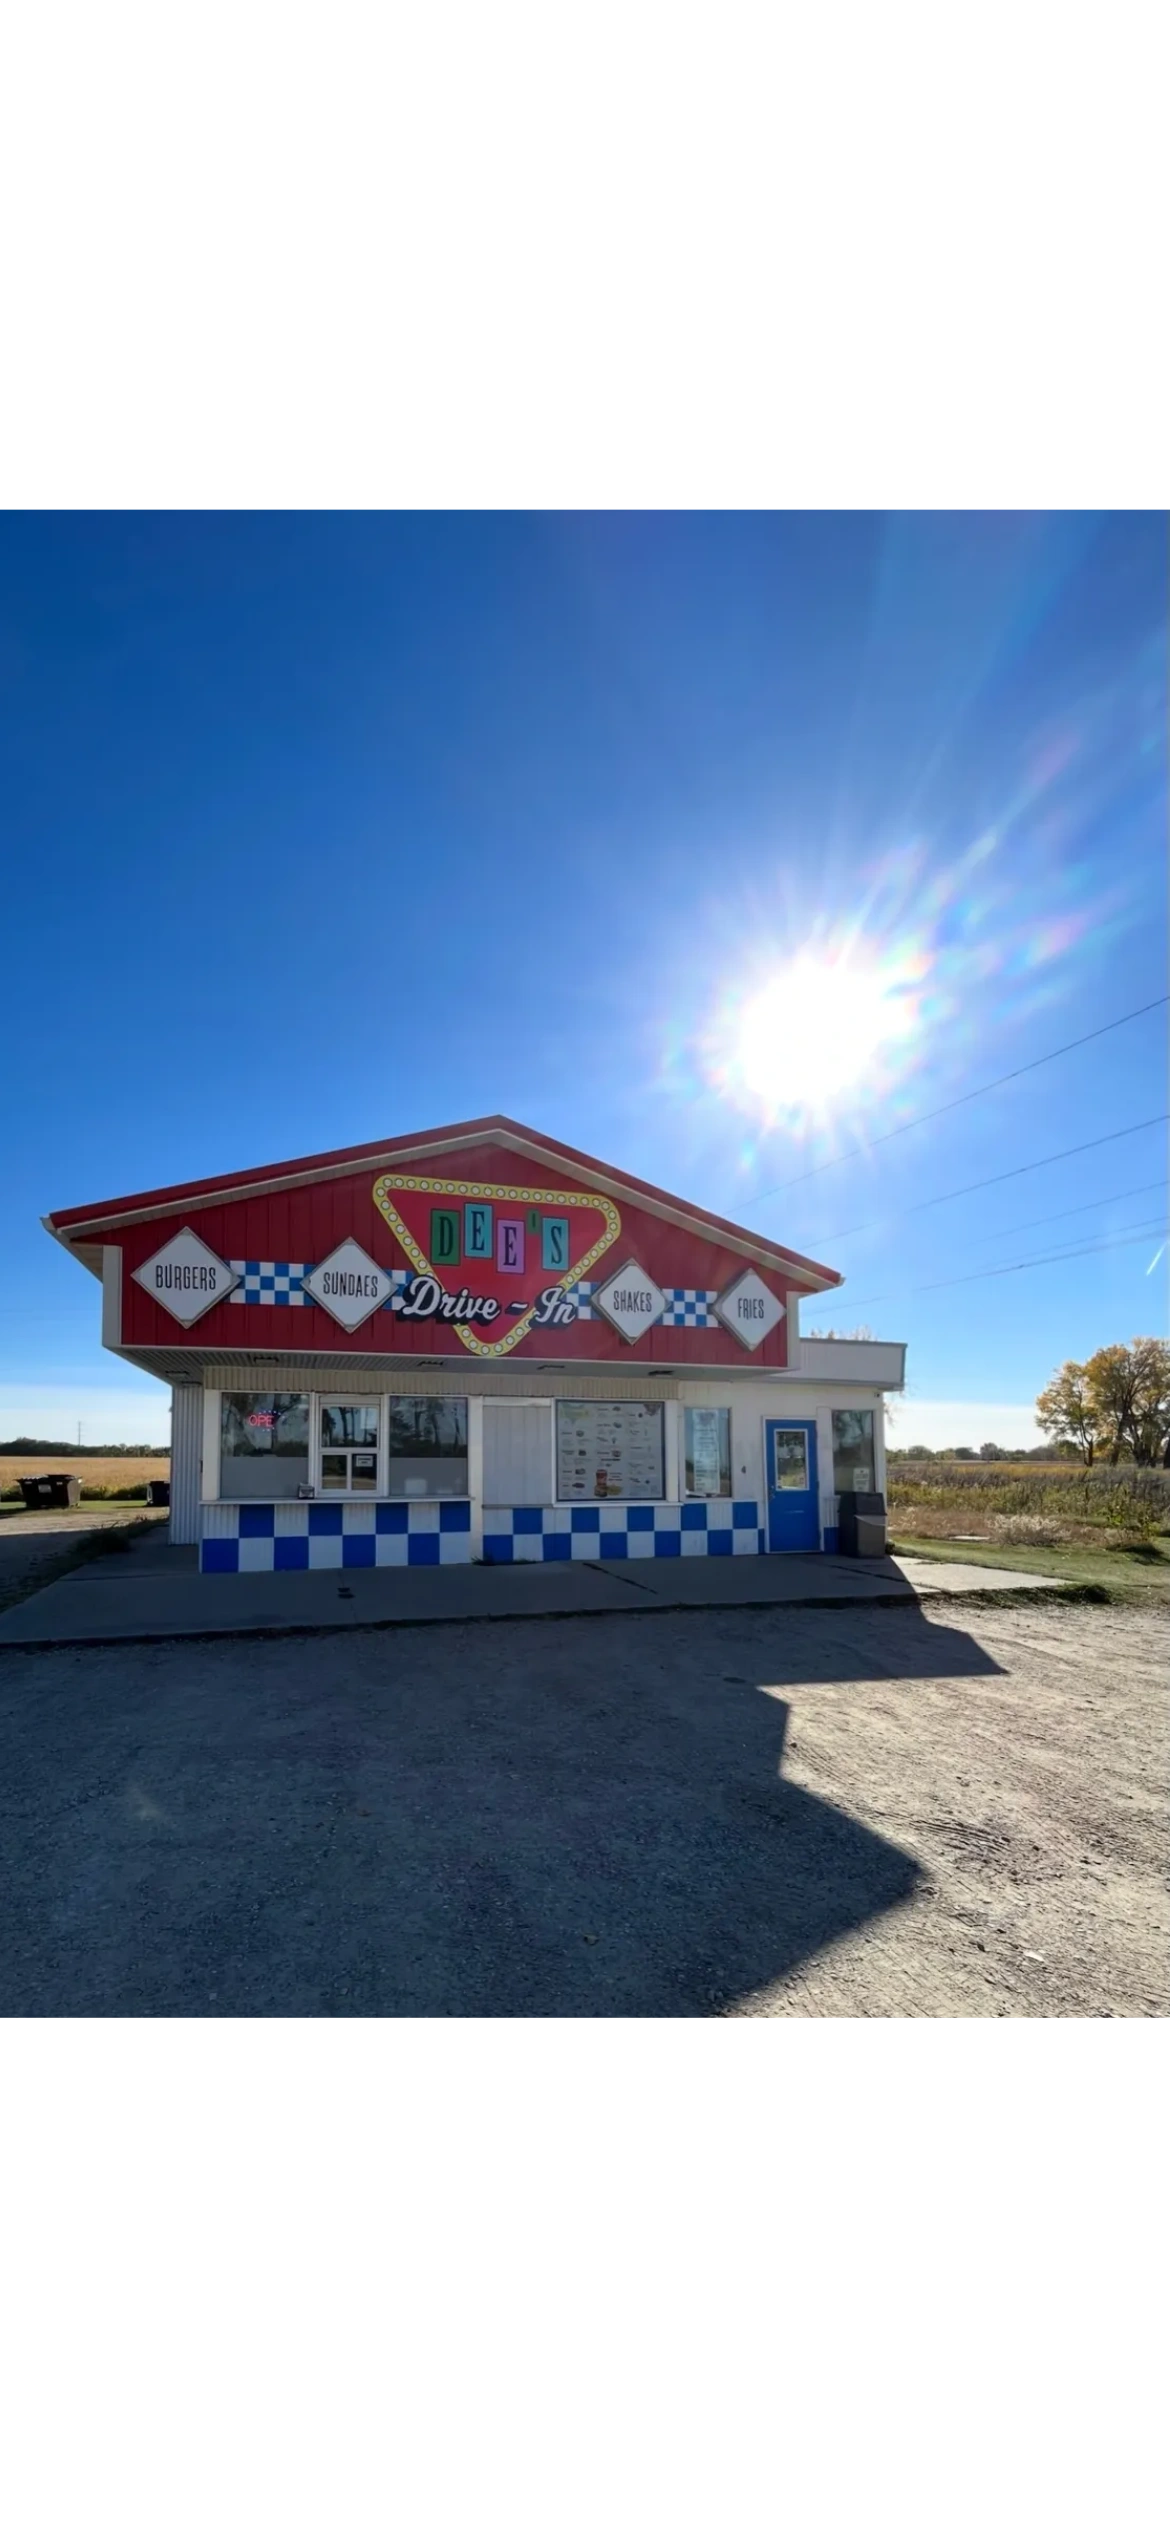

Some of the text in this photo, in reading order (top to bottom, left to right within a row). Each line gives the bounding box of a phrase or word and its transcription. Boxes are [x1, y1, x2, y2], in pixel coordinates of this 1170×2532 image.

[437, 1210, 563, 1266] DEE'S
[154, 1263, 217, 1292] BURGERS
[322, 1270, 379, 1298] SUNDAES
[402, 1275, 500, 1320] Drive
[534, 1286, 576, 1324] In
[613, 1289, 653, 1314] SHAKES
[737, 1297, 765, 1320] FRIES
[249, 1414, 276, 1427] OPE
